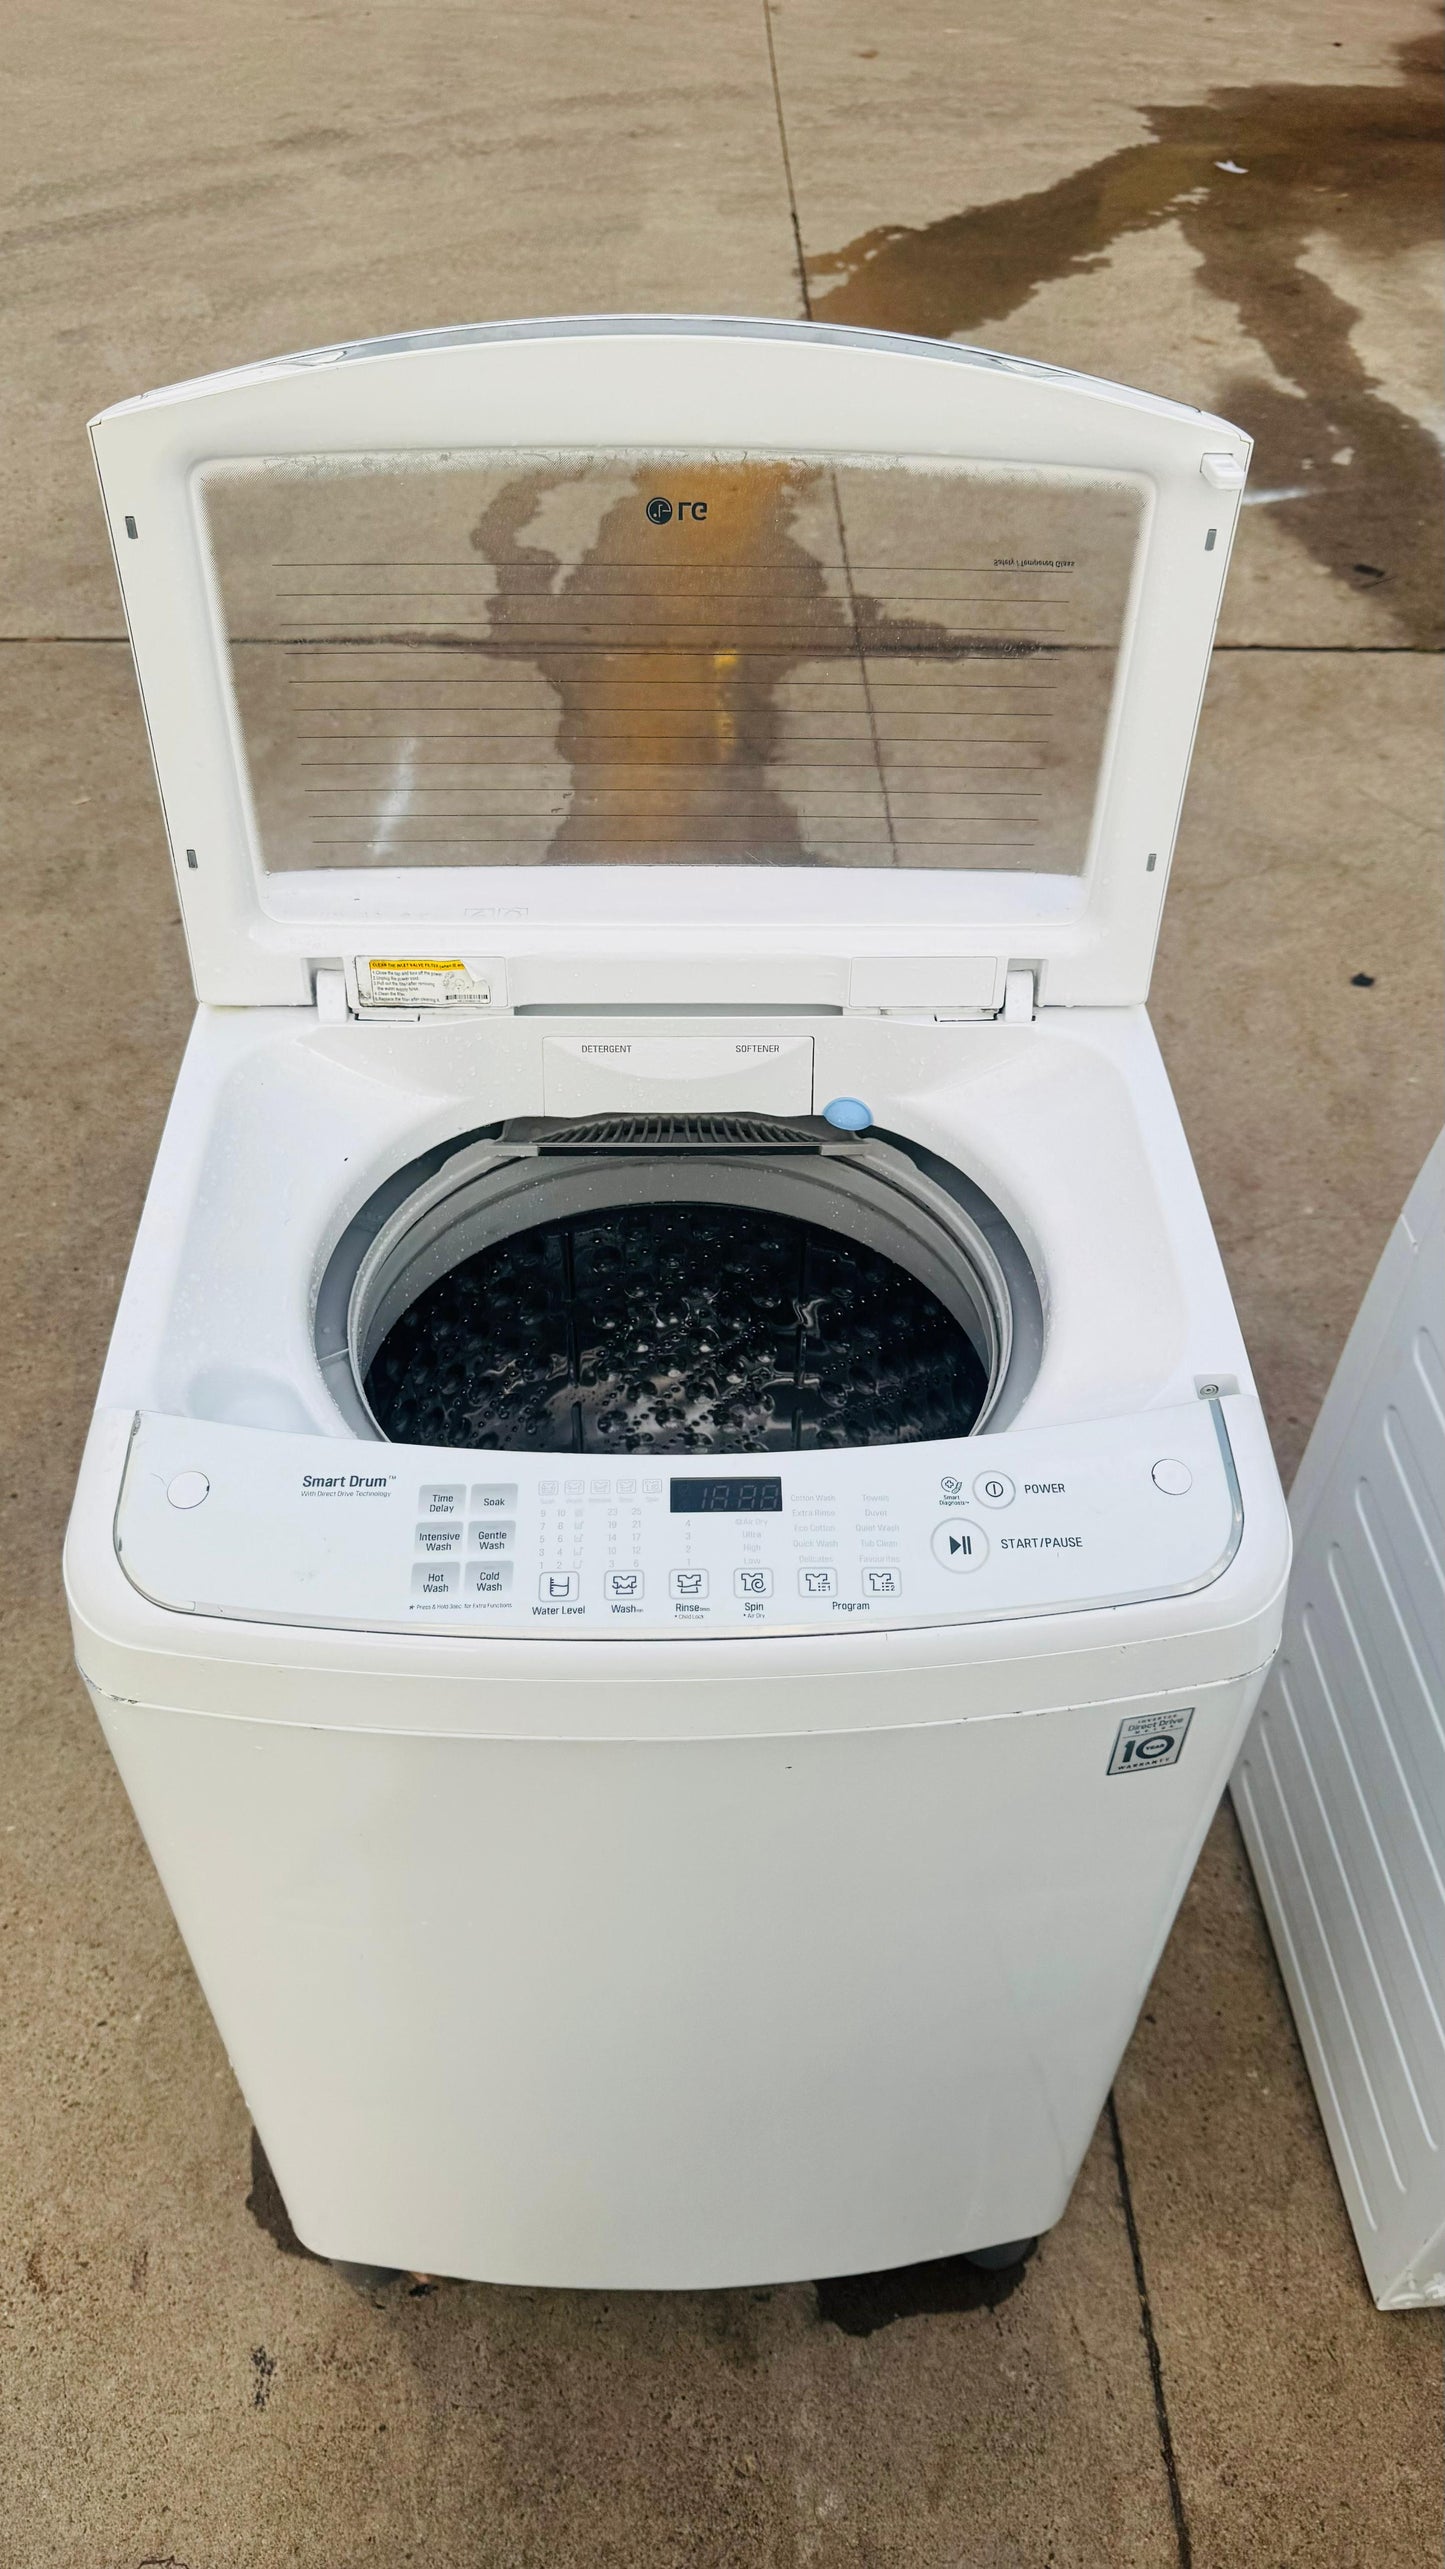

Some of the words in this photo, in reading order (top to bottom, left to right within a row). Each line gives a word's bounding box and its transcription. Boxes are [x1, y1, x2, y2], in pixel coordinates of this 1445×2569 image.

[581, 1044, 632, 1053] DETERGENT
[735, 1044, 780, 1053] SOFTENER
[302, 1475, 347, 1487] Smart
[1024, 1483, 1066, 1494] POWER
[355, 1490, 392, 1498] Technology
[432, 1494, 454, 1503] Time
[483, 1497, 505, 1506] Soak
[429, 1504, 455, 1513] Delay
[419, 1532, 461, 1541] Intensive
[478, 1531, 508, 1540] Gentle
[426, 1542, 452, 1551] Wash
[479, 1541, 505, 1550] Wash
[1000, 1537, 1083, 1550] START/PAUSE
[427, 1573, 444, 1582] Hot
[480, 1571, 500, 1581] Cold
[422, 1584, 449, 1593] Wash
[476, 1582, 503, 1592] Wash
[532, 1605, 559, 1615] Water
[561, 1605, 586, 1615] Level
[675, 1602, 700, 1612] Rinse
[744, 1601, 764, 1613] Spin
[832, 1601, 870, 1612] Program
[1128, 1721, 1157, 1732] Direct
[1159, 1717, 1184, 1727] Drive
